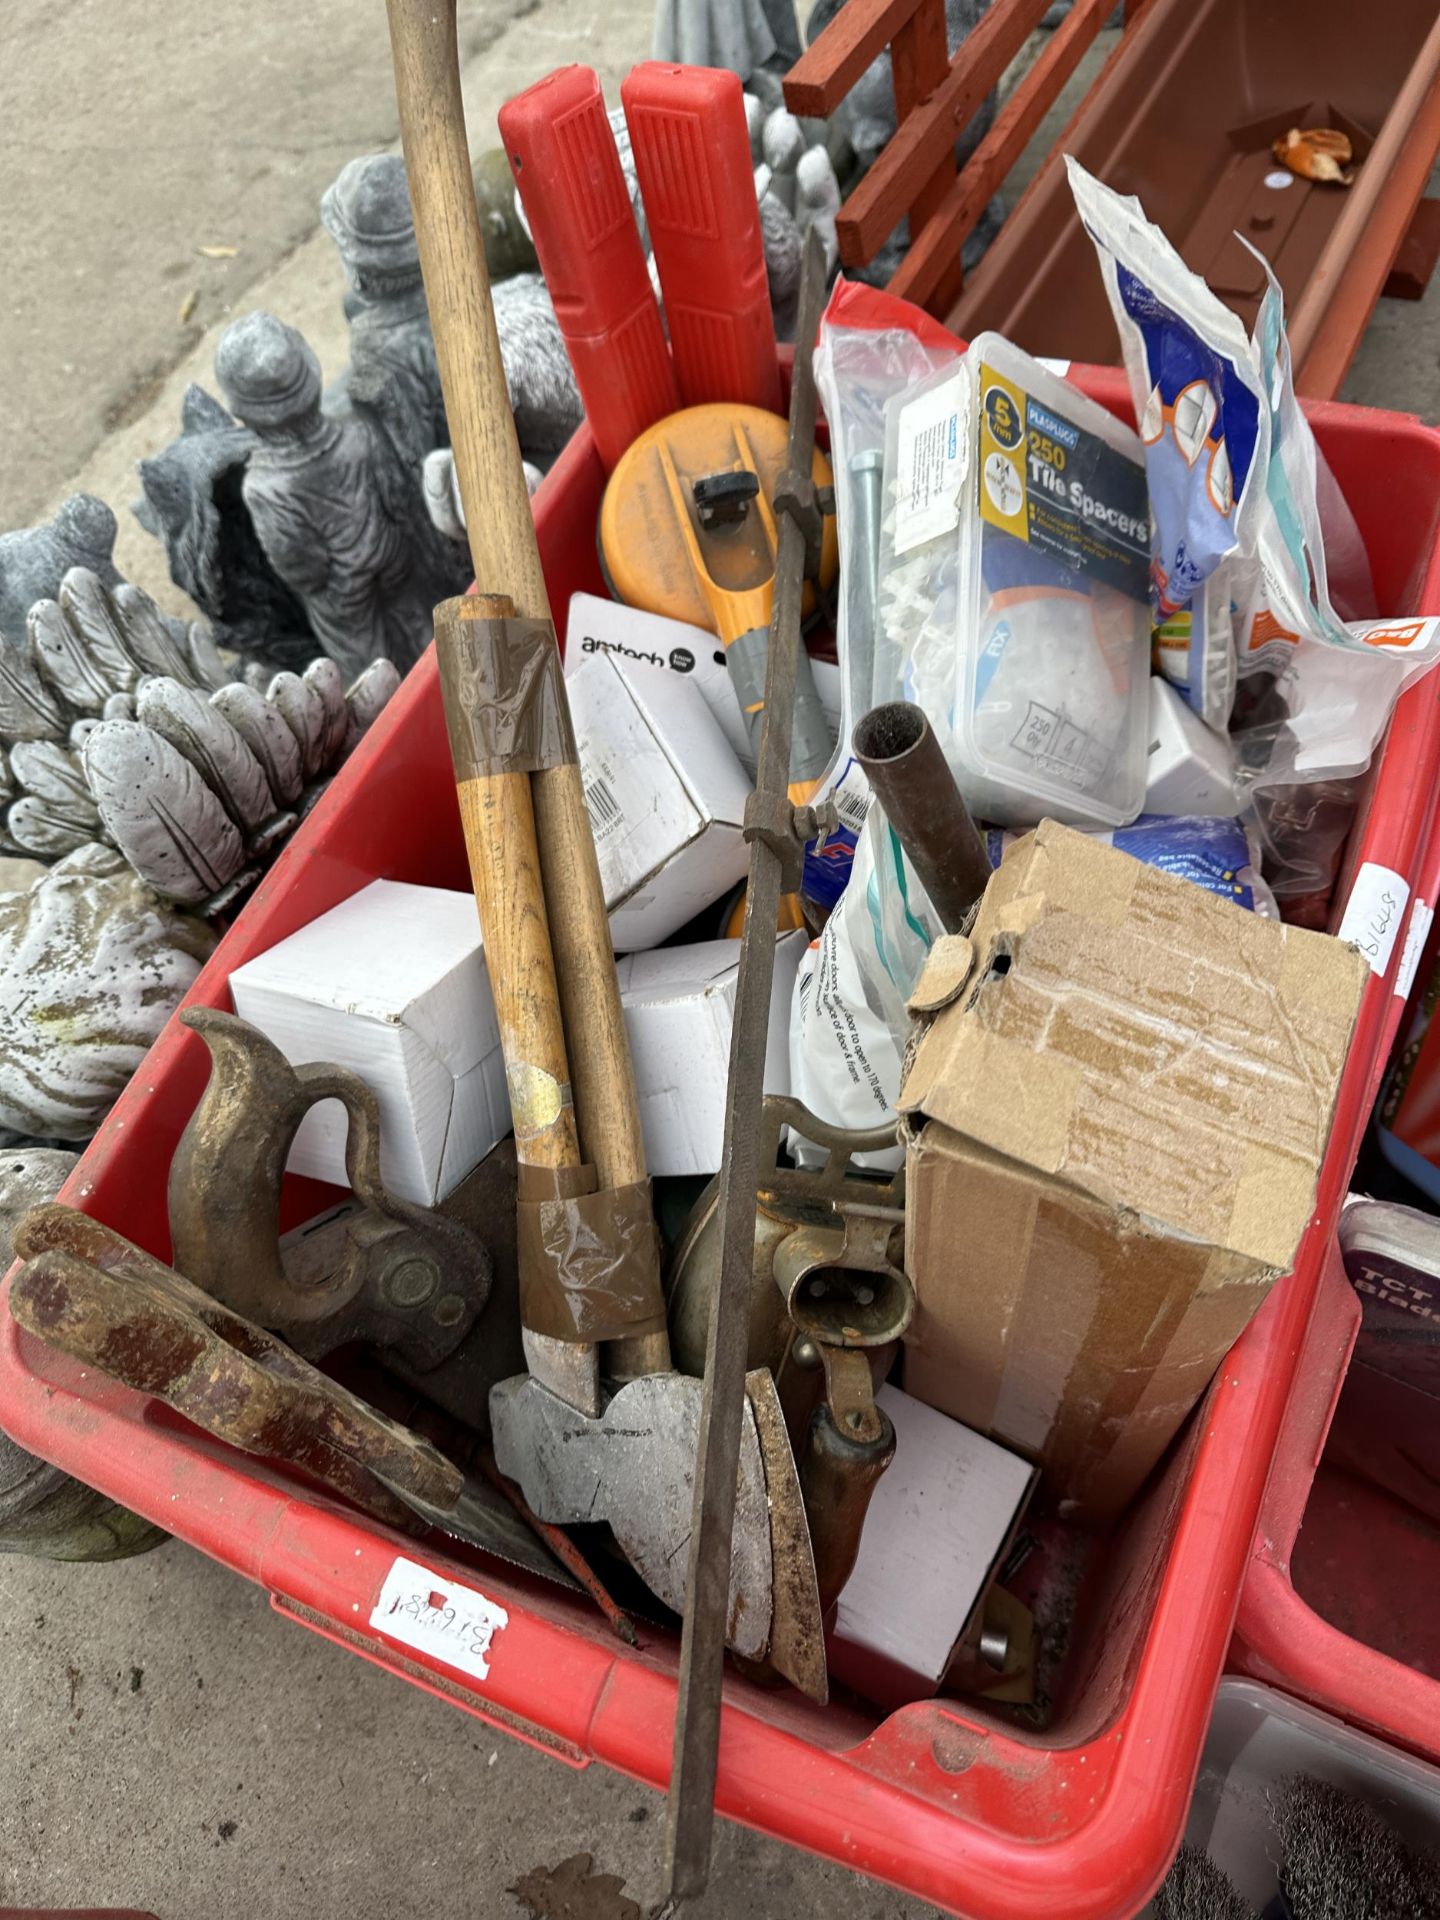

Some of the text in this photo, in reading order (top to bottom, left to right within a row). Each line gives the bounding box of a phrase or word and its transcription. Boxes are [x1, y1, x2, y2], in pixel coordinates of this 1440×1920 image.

[994, 397, 1012, 426] 5
[993, 423, 1012, 441] mm
[1028, 408, 1078, 447] PLASPLUGS
[1030, 431, 1067, 471] 250
[1028, 455, 1066, 496] Tile
[1070, 481, 1148, 543] Spacers
[986, 630, 1009, 657] FIX
[1030, 715, 1051, 736] 250
[833, 1018, 843, 1031] of
[836, 1031, 849, 1054] door
[850, 1033, 859, 1044] to
[854, 1044, 868, 1067] open
[863, 1064, 872, 1074] to
[866, 1072, 880, 1087] 170
[1360, 1266, 1433, 1300] TCT
